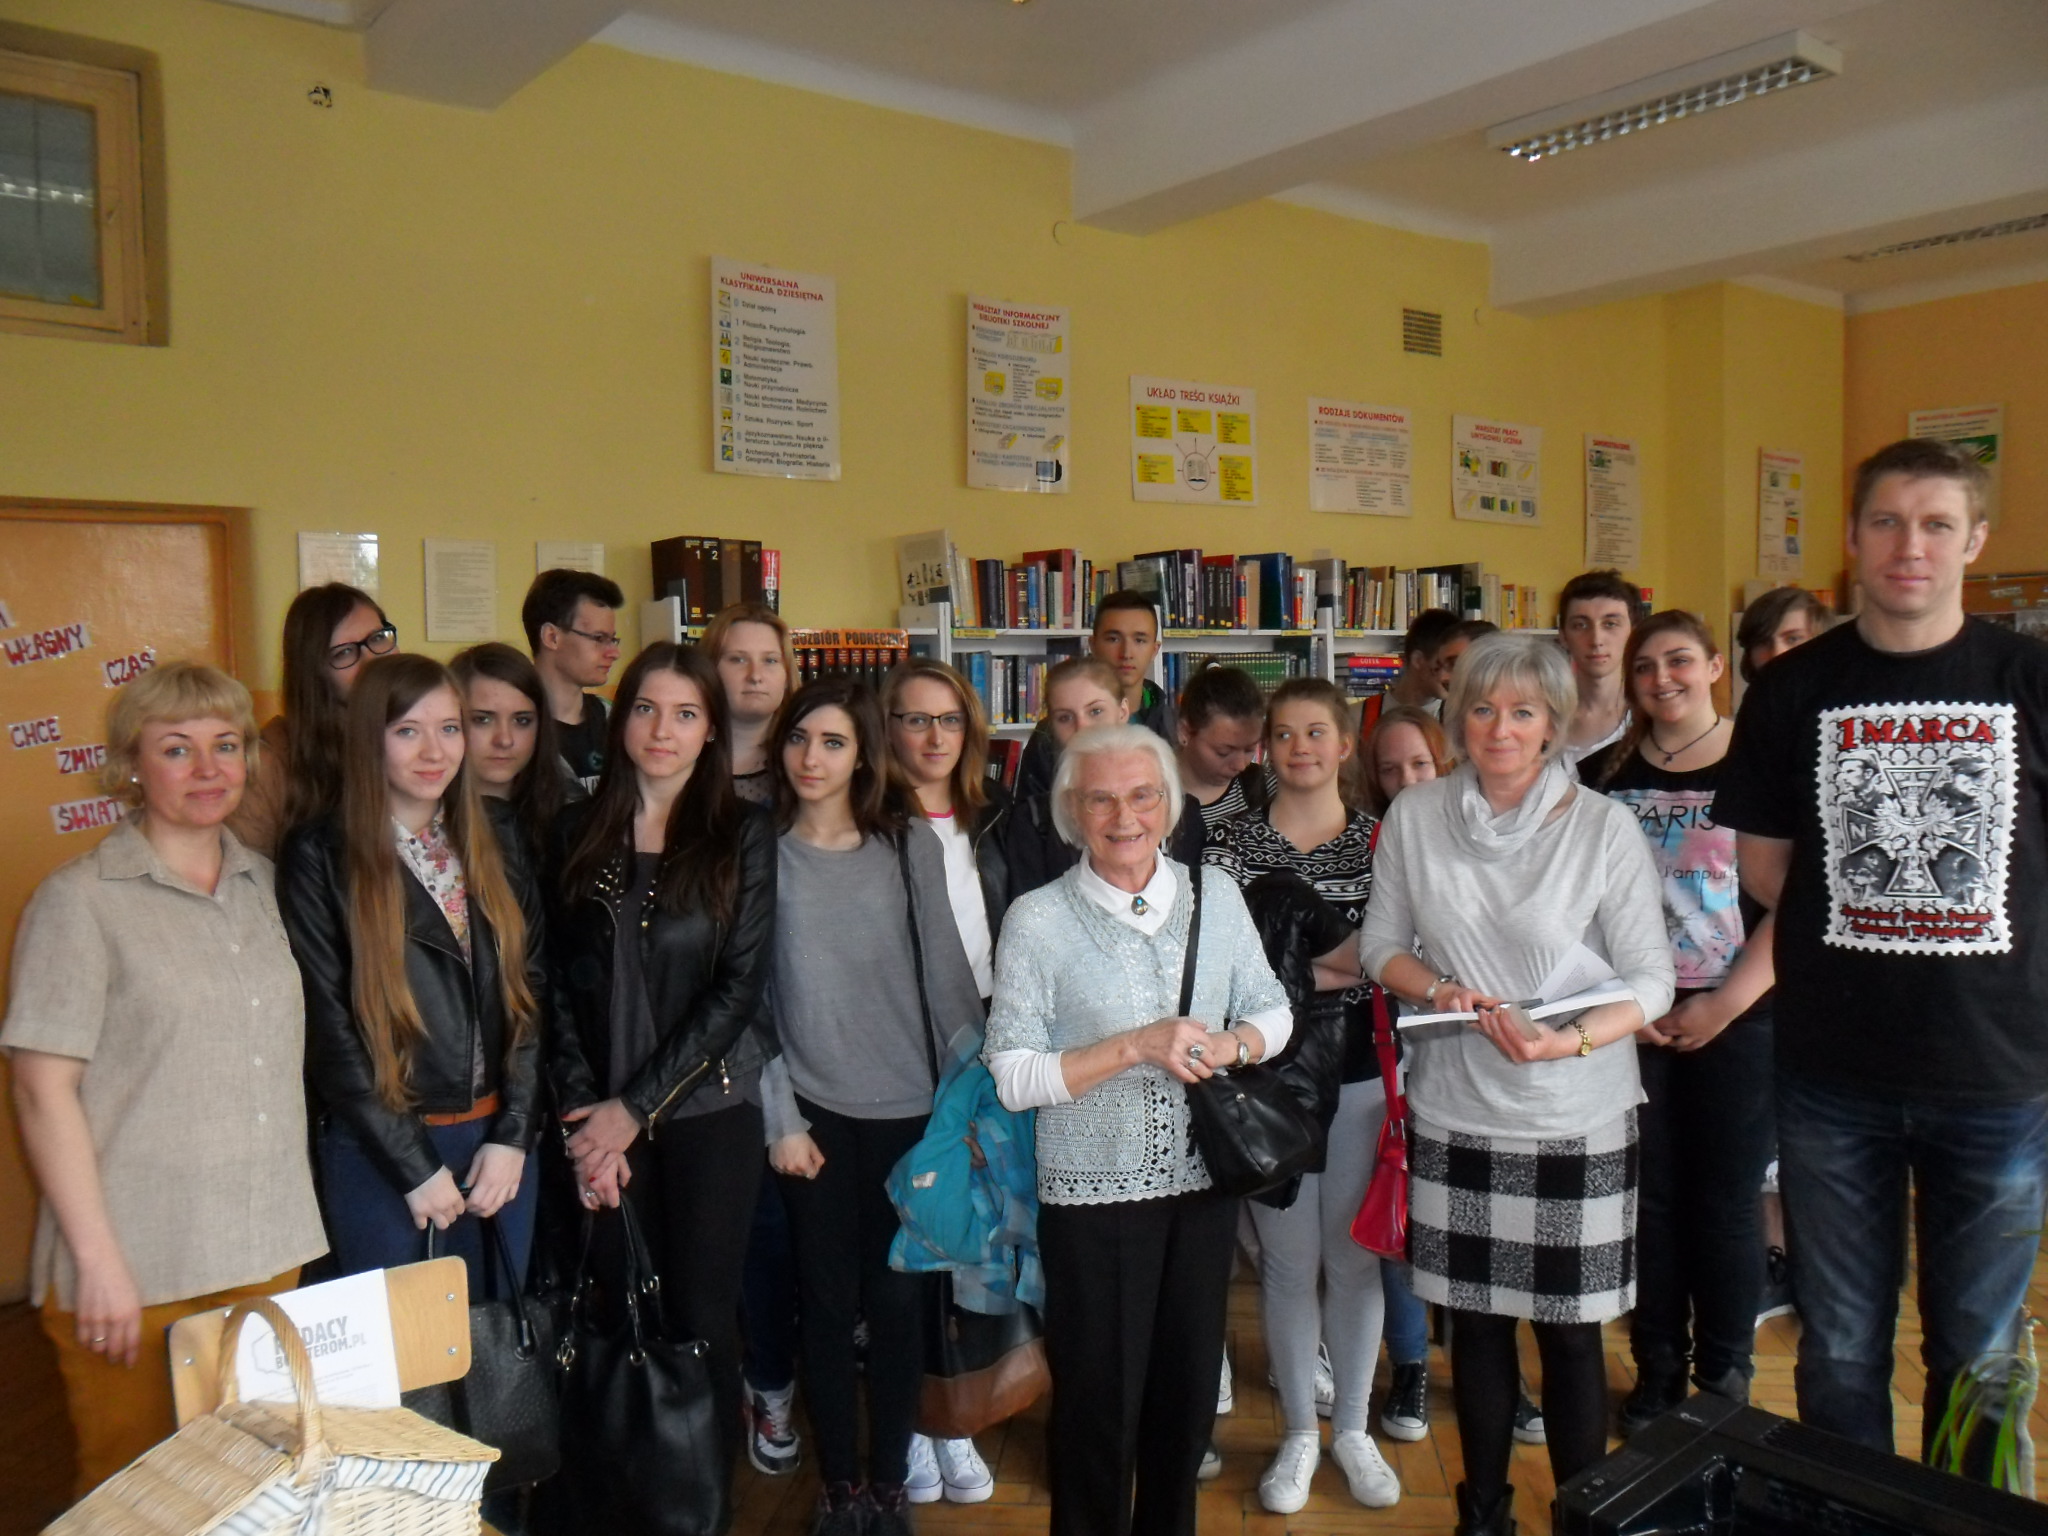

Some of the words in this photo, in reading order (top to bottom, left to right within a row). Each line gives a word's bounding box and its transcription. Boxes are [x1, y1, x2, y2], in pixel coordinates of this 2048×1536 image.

[720, 276, 774, 295] KLASYFIKACJA
[740, 272, 799, 289] UNIWERSALNA
[1003, 310, 1061, 322] INFORMACYJNY
[1012, 320, 1050, 330] SZKOLNEJ
[1146, 386, 1176, 400] UKŁAD
[1180, 388, 1205, 402] TREŚCI
[1208, 392, 1240, 406] KSIĄŻKI
[1318, 406, 1351, 418] RODZAJE
[1352, 410, 1405, 424] DOKUMENTÓW
[696, 550, 701, 560] 1
[712, 550, 719, 560] 2
[4, 624, 85, 667] WŁASNY
[106, 652, 155, 686] CZAS
[11, 718, 61, 748] CHCE
[1837, 717, 1859, 750] 1
[1862, 718, 1997, 744] MARCA
[1850, 823, 1867, 842] N
[1962, 823, 1979, 845] Z
